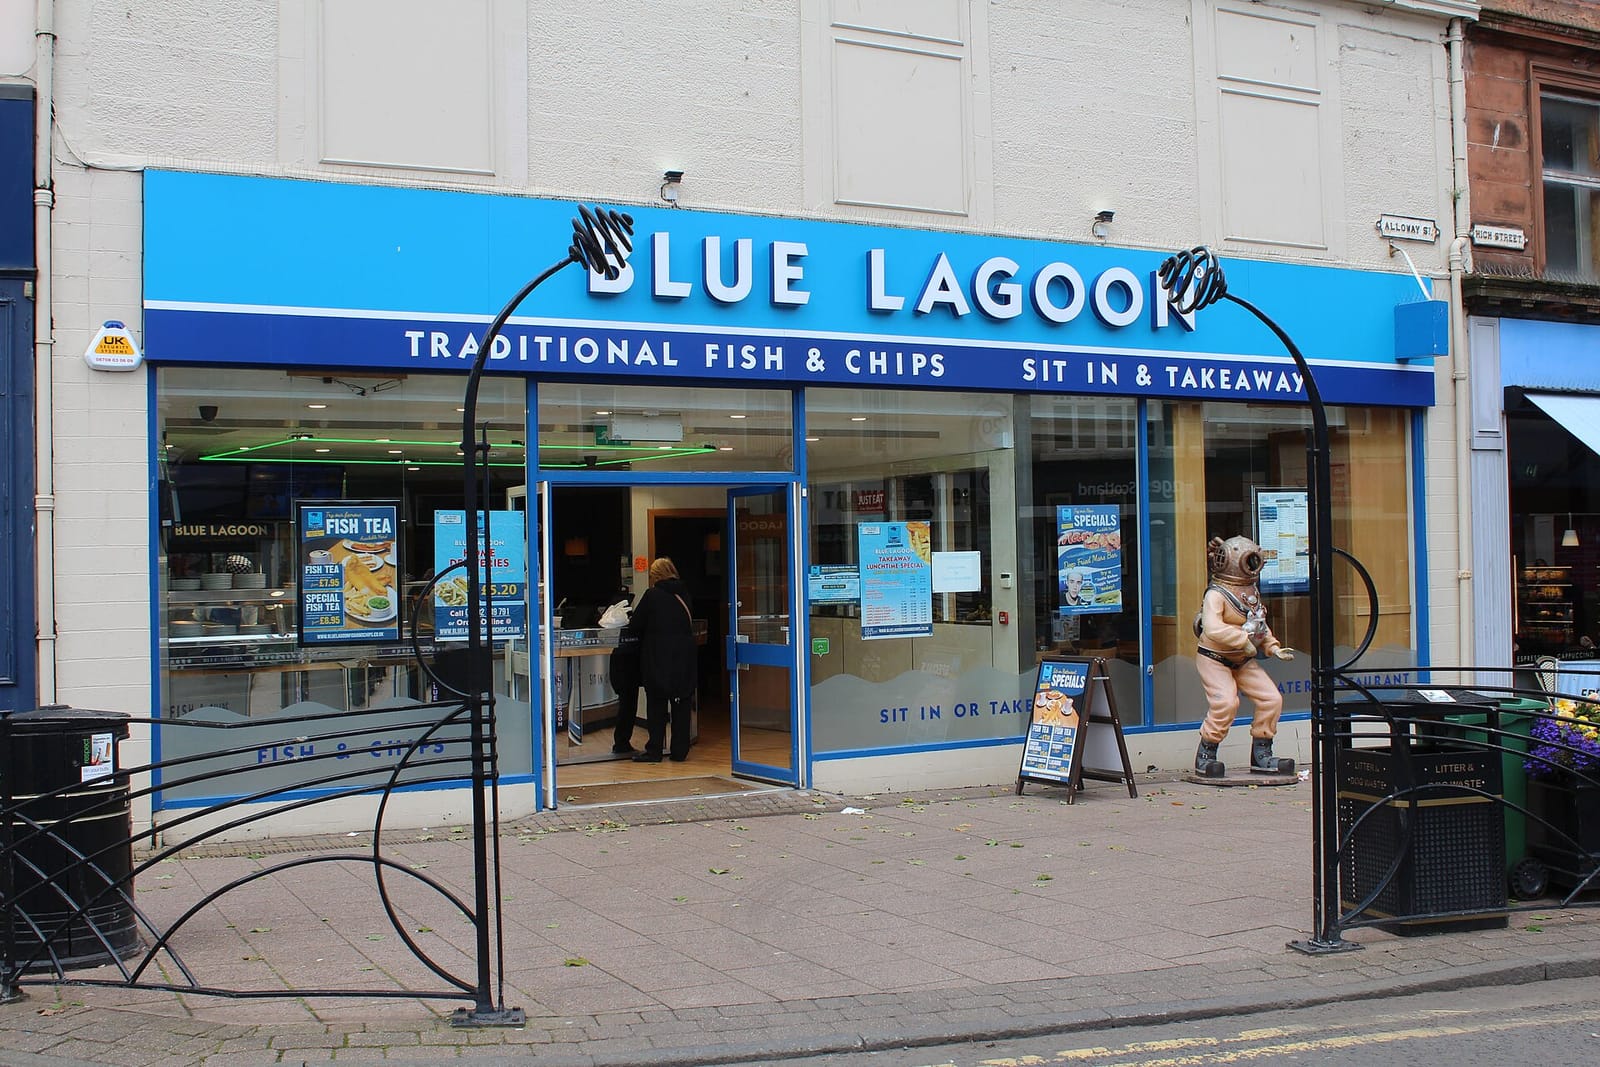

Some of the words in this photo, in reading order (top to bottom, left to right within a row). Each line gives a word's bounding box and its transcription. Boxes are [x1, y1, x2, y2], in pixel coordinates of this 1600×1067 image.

[1384, 221, 1420, 235] ALLOWAY
[1475, 229, 1493, 240] HIGH
[587, 224, 811, 306] BLUE
[866, 247, 1198, 333] LAGOON
[104, 336, 124, 345] UK
[404, 330, 679, 367] TRADITIONAL
[705, 344, 783, 371] FISH
[806, 347, 826, 373] &
[845, 349, 945, 378] CHIPS
[1022, 358, 1067, 383] SIT
[1087, 361, 1118, 386] IN
[1135, 364, 1152, 387] &
[1165, 365, 1304, 394] TAKEAWAY
[858, 495, 872, 505] JUST
[873, 493, 885, 504] EAT
[326, 518, 359, 534] FISH
[363, 518, 392, 533] TEA
[1073, 514, 1117, 527] SPECIALS
[175, 525, 206, 536] BLUE
[210, 525, 268, 536] LAGOON
[463, 549, 495, 557] HME
[305, 565, 322, 574] FISH
[324, 565, 340, 574] TEA
[306, 594, 340, 603] SPECIAL
[306, 603, 323, 612] FISH
[325, 603, 340, 611] TEA
[449, 609, 464, 617] Call
[1050, 674, 1086, 688] SPECIALS
[880, 708, 909, 723] SIT
[920, 705, 941, 721] IN
[954, 702, 979, 718] OR
[257, 744, 315, 764] FISH
[370, 739, 446, 757] CHPS
[1354, 762, 1374, 772] LITTER
[1435, 763, 1466, 774] LITTER
[1467, 763, 1474, 772] &
